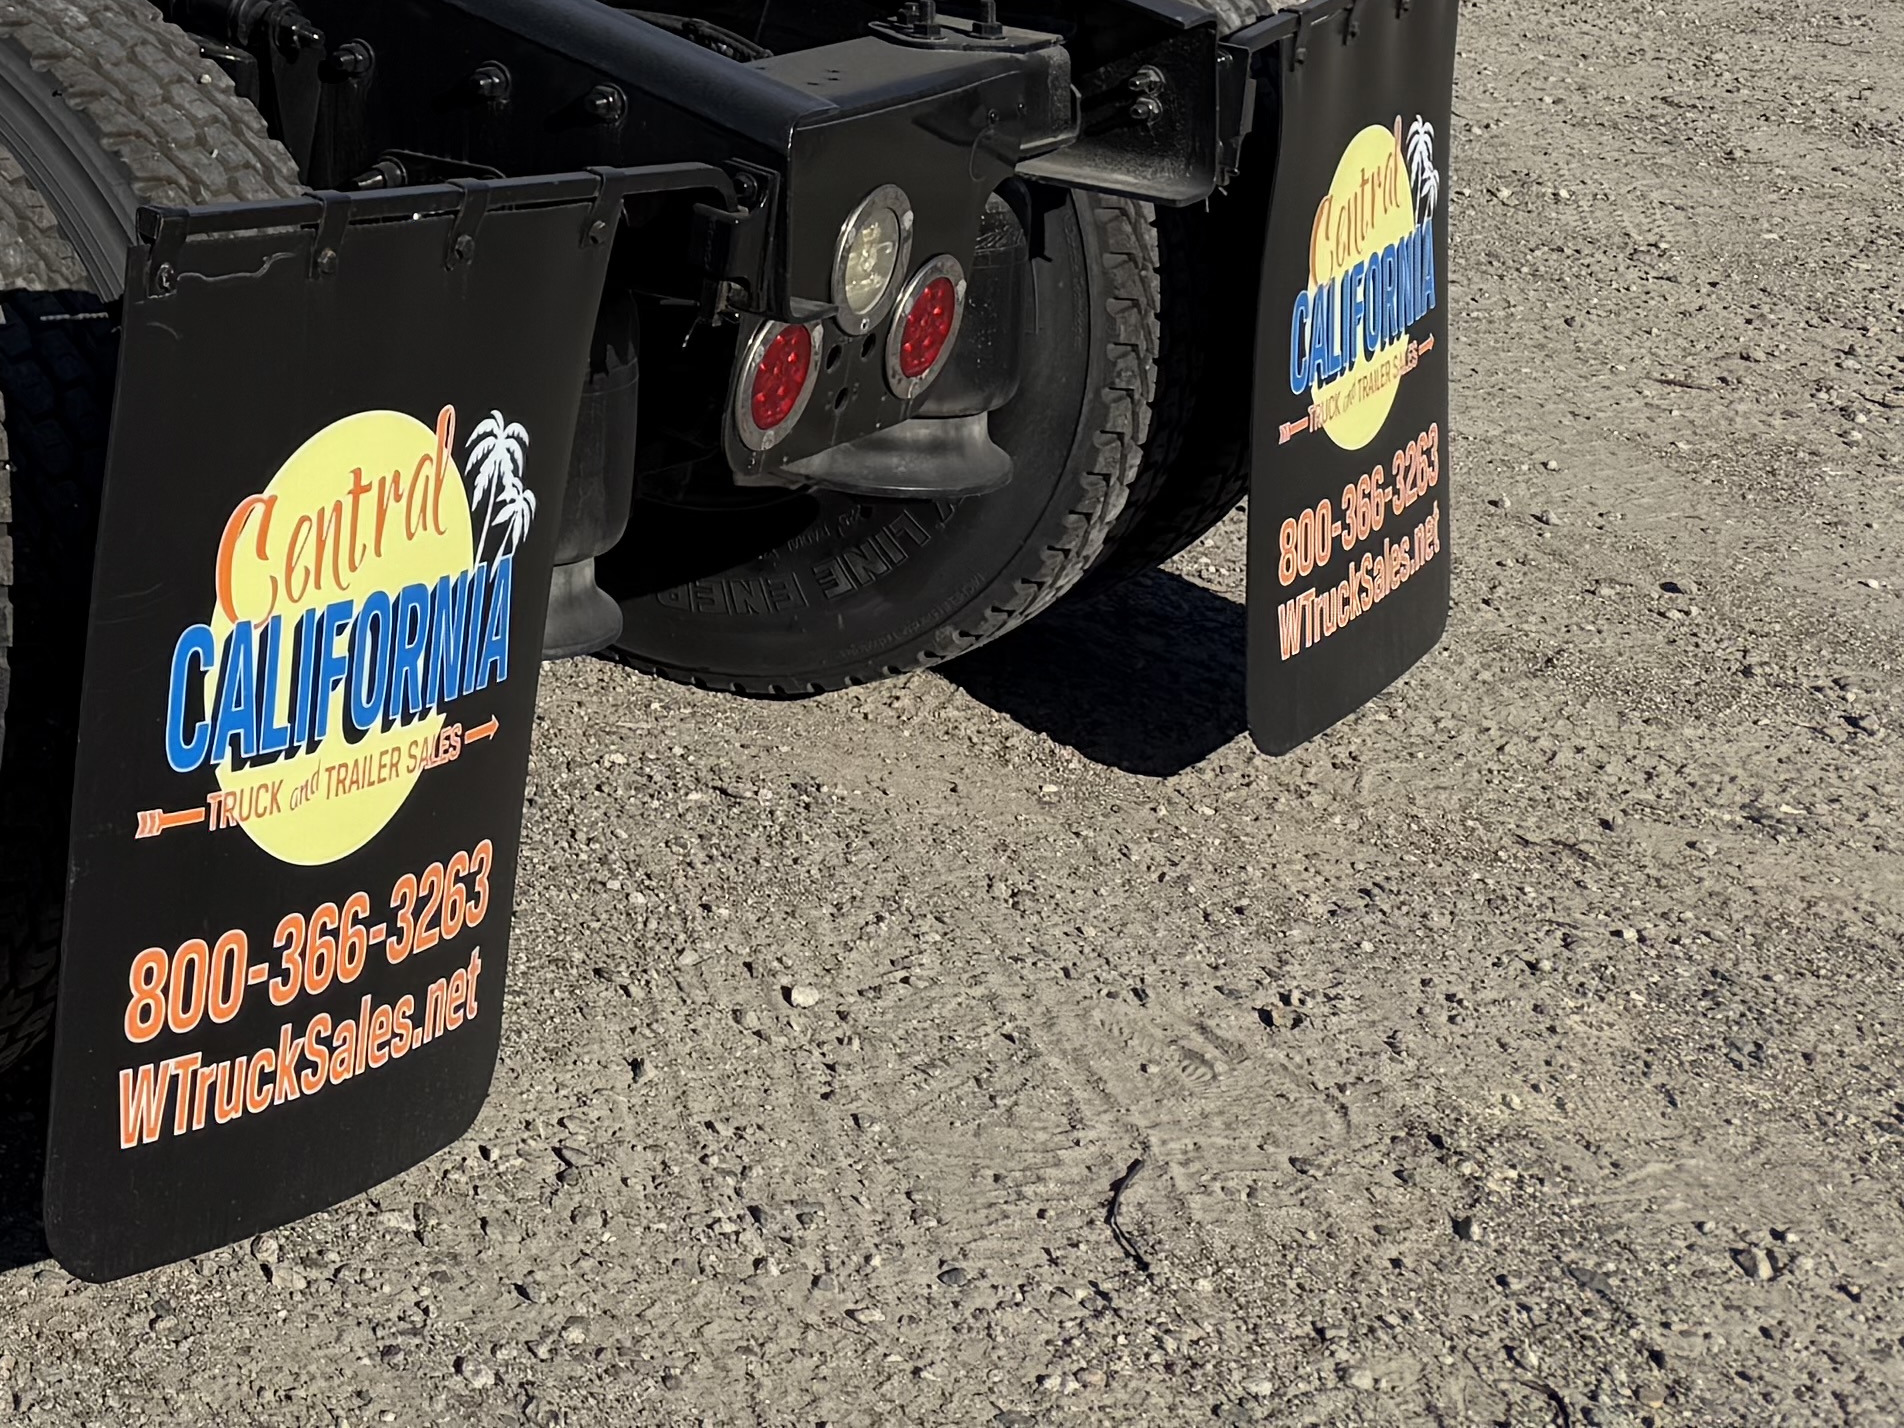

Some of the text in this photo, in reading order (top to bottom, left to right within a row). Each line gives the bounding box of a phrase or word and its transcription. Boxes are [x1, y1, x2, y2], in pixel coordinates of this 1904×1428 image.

[1309, 114, 1403, 287] Central
[1289, 218, 1436, 395] CALIFORNIA
[1308, 389, 1341, 433] TRUCK
[1356, 356, 1392, 404] TRAILER
[215, 404, 456, 629] Central
[813, 508, 931, 600] LINE
[1278, 422, 1439, 586] 800-366-3263
[1278, 500, 1441, 661] WTruckSales.net
[165, 555, 513, 773] CALIFORNIA
[206, 722, 462, 832] TRUCK and TRAILER SALES
[124, 838, 493, 1044] 800-366-3263
[118, 945, 482, 1150] WTruckSales.net
